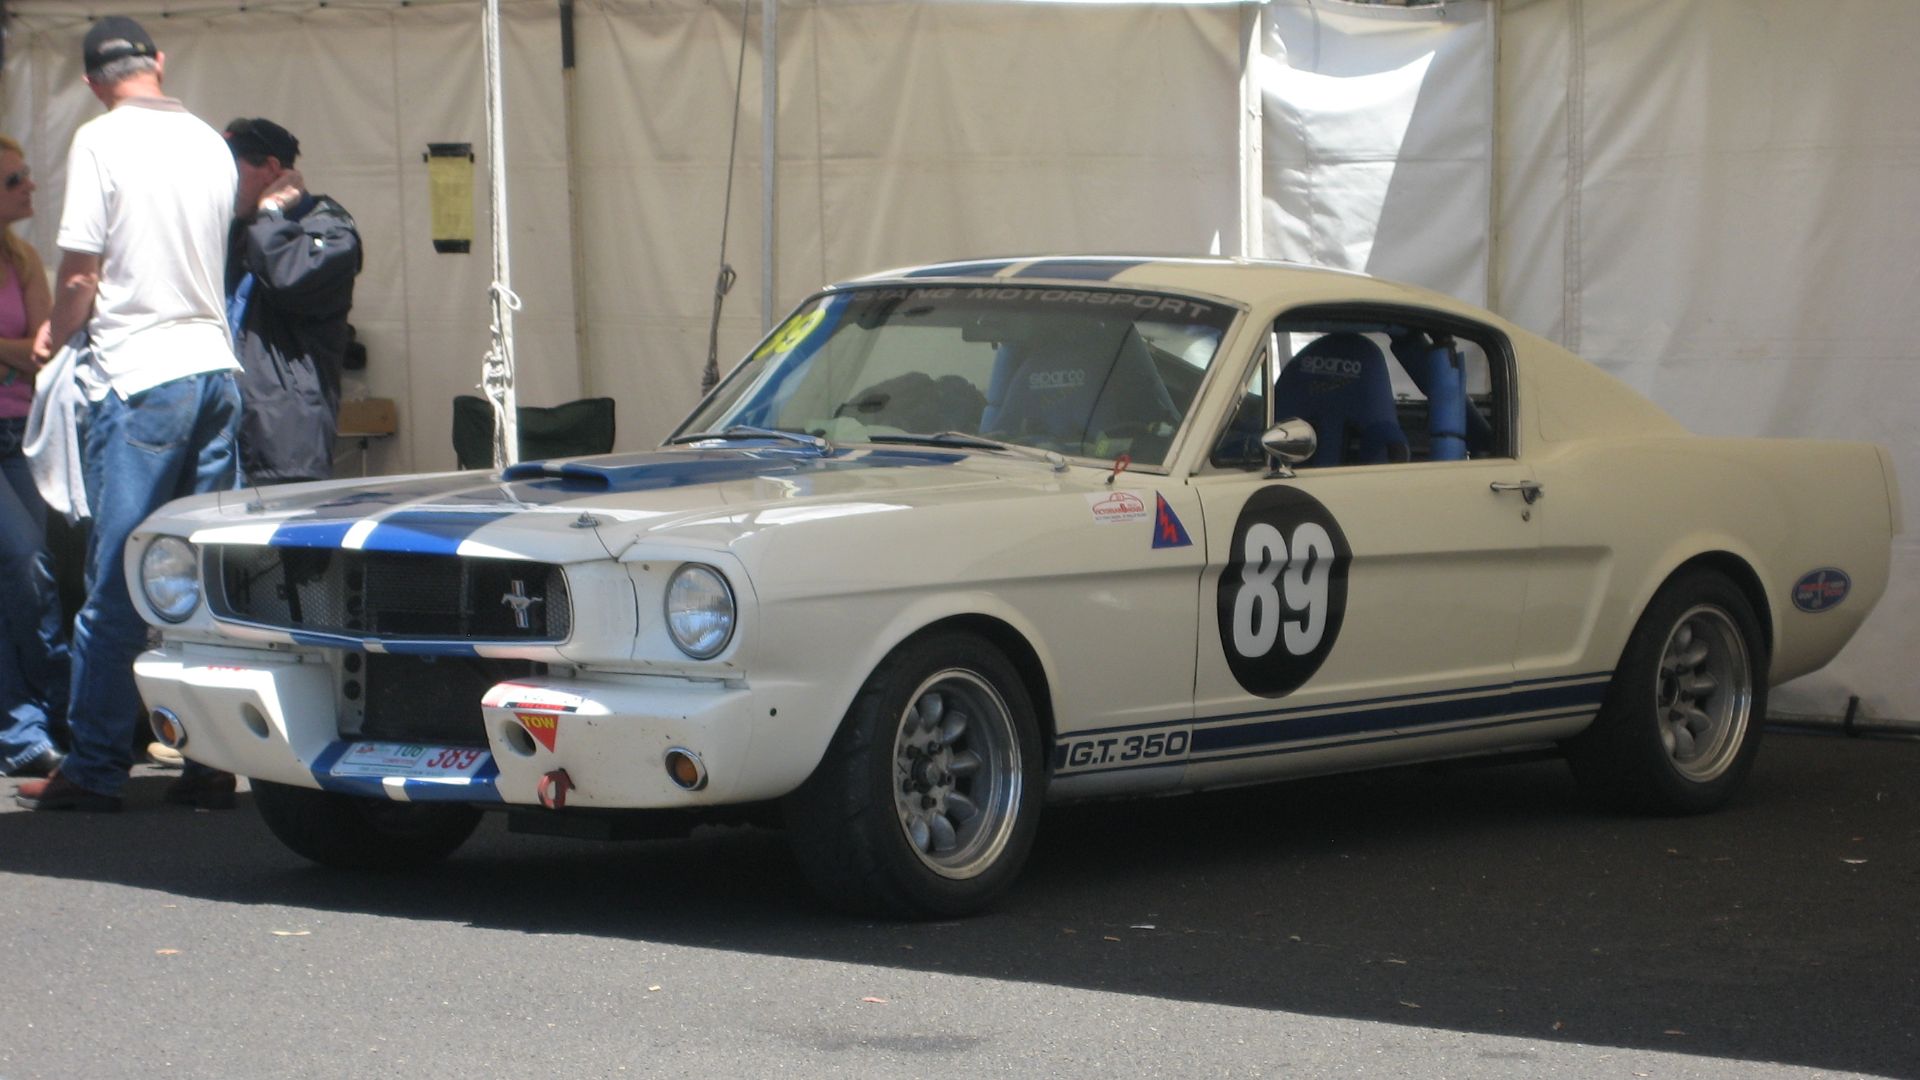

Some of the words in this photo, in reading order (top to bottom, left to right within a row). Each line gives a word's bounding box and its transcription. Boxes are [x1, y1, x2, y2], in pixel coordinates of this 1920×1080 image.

[967, 287, 1212, 319] MOTORSPORT
[1302, 356, 1362, 375] sparco
[1233, 522, 1335, 658] 89
[521, 715, 555, 729] TOW
[427, 749, 483, 770] 389
